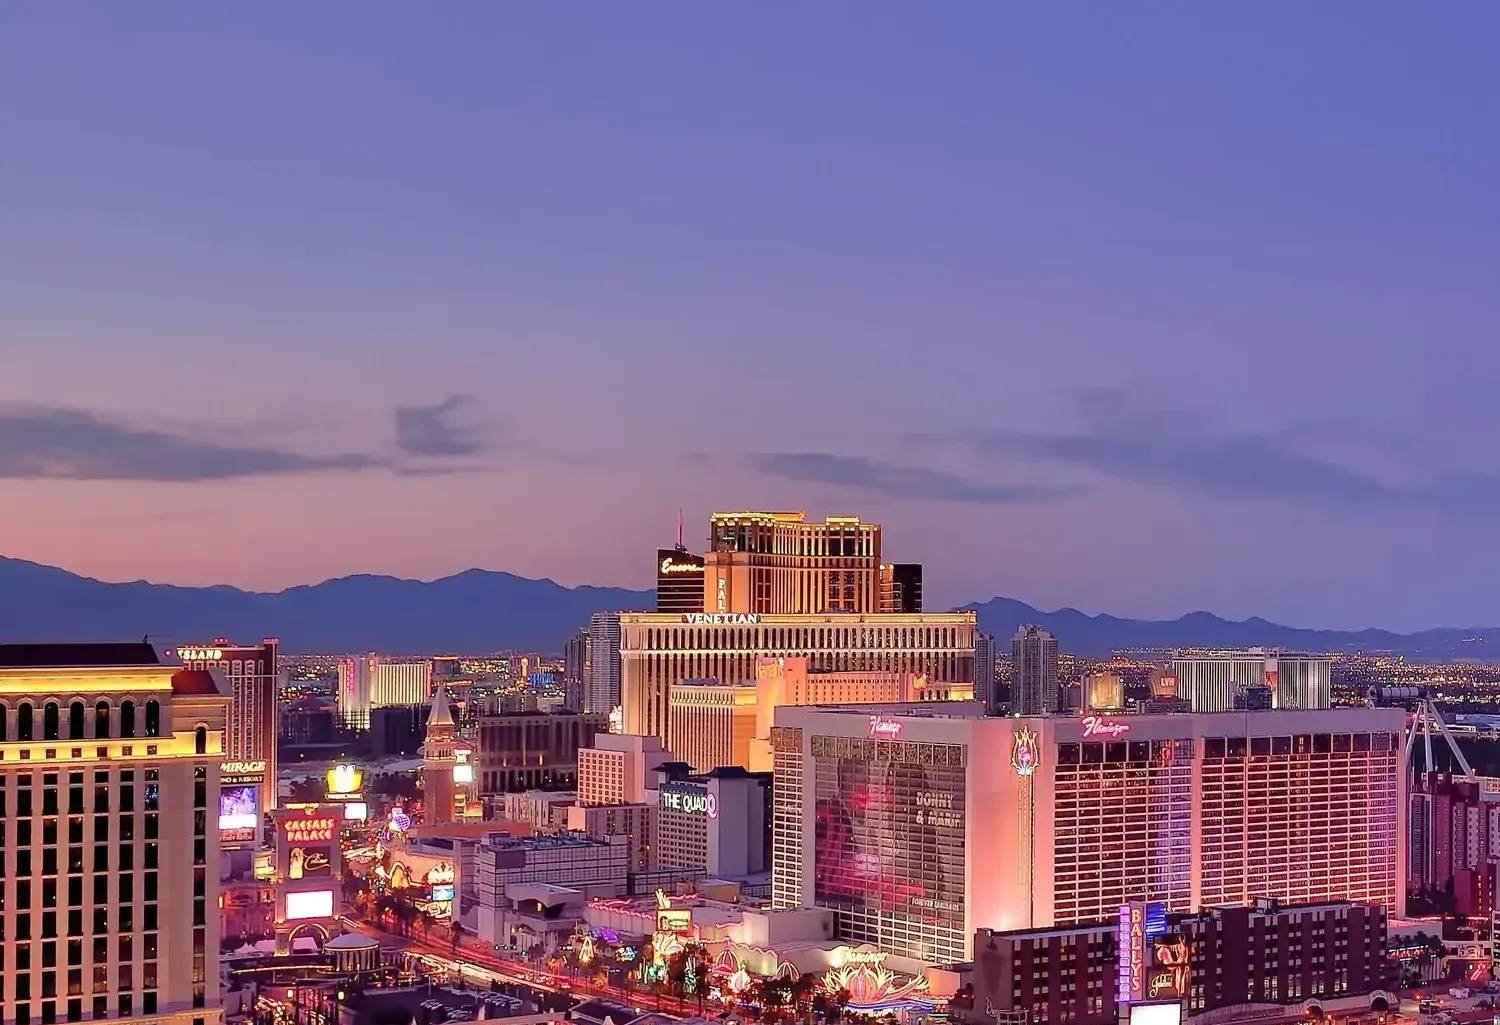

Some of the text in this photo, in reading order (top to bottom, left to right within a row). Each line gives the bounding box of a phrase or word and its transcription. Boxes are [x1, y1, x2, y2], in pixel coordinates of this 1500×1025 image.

[661, 557, 704, 573] Encore
[685, 613, 758, 624] VENETIAN
[869, 714, 902, 738] Flamingo
[1081, 716, 1130, 737] Flamingo
[220, 761, 266, 773] MIRAGE
[662, 792, 708, 813] THE QUAD
[284, 819, 335, 831] CAESARS
[287, 829, 332, 842] PALACE
